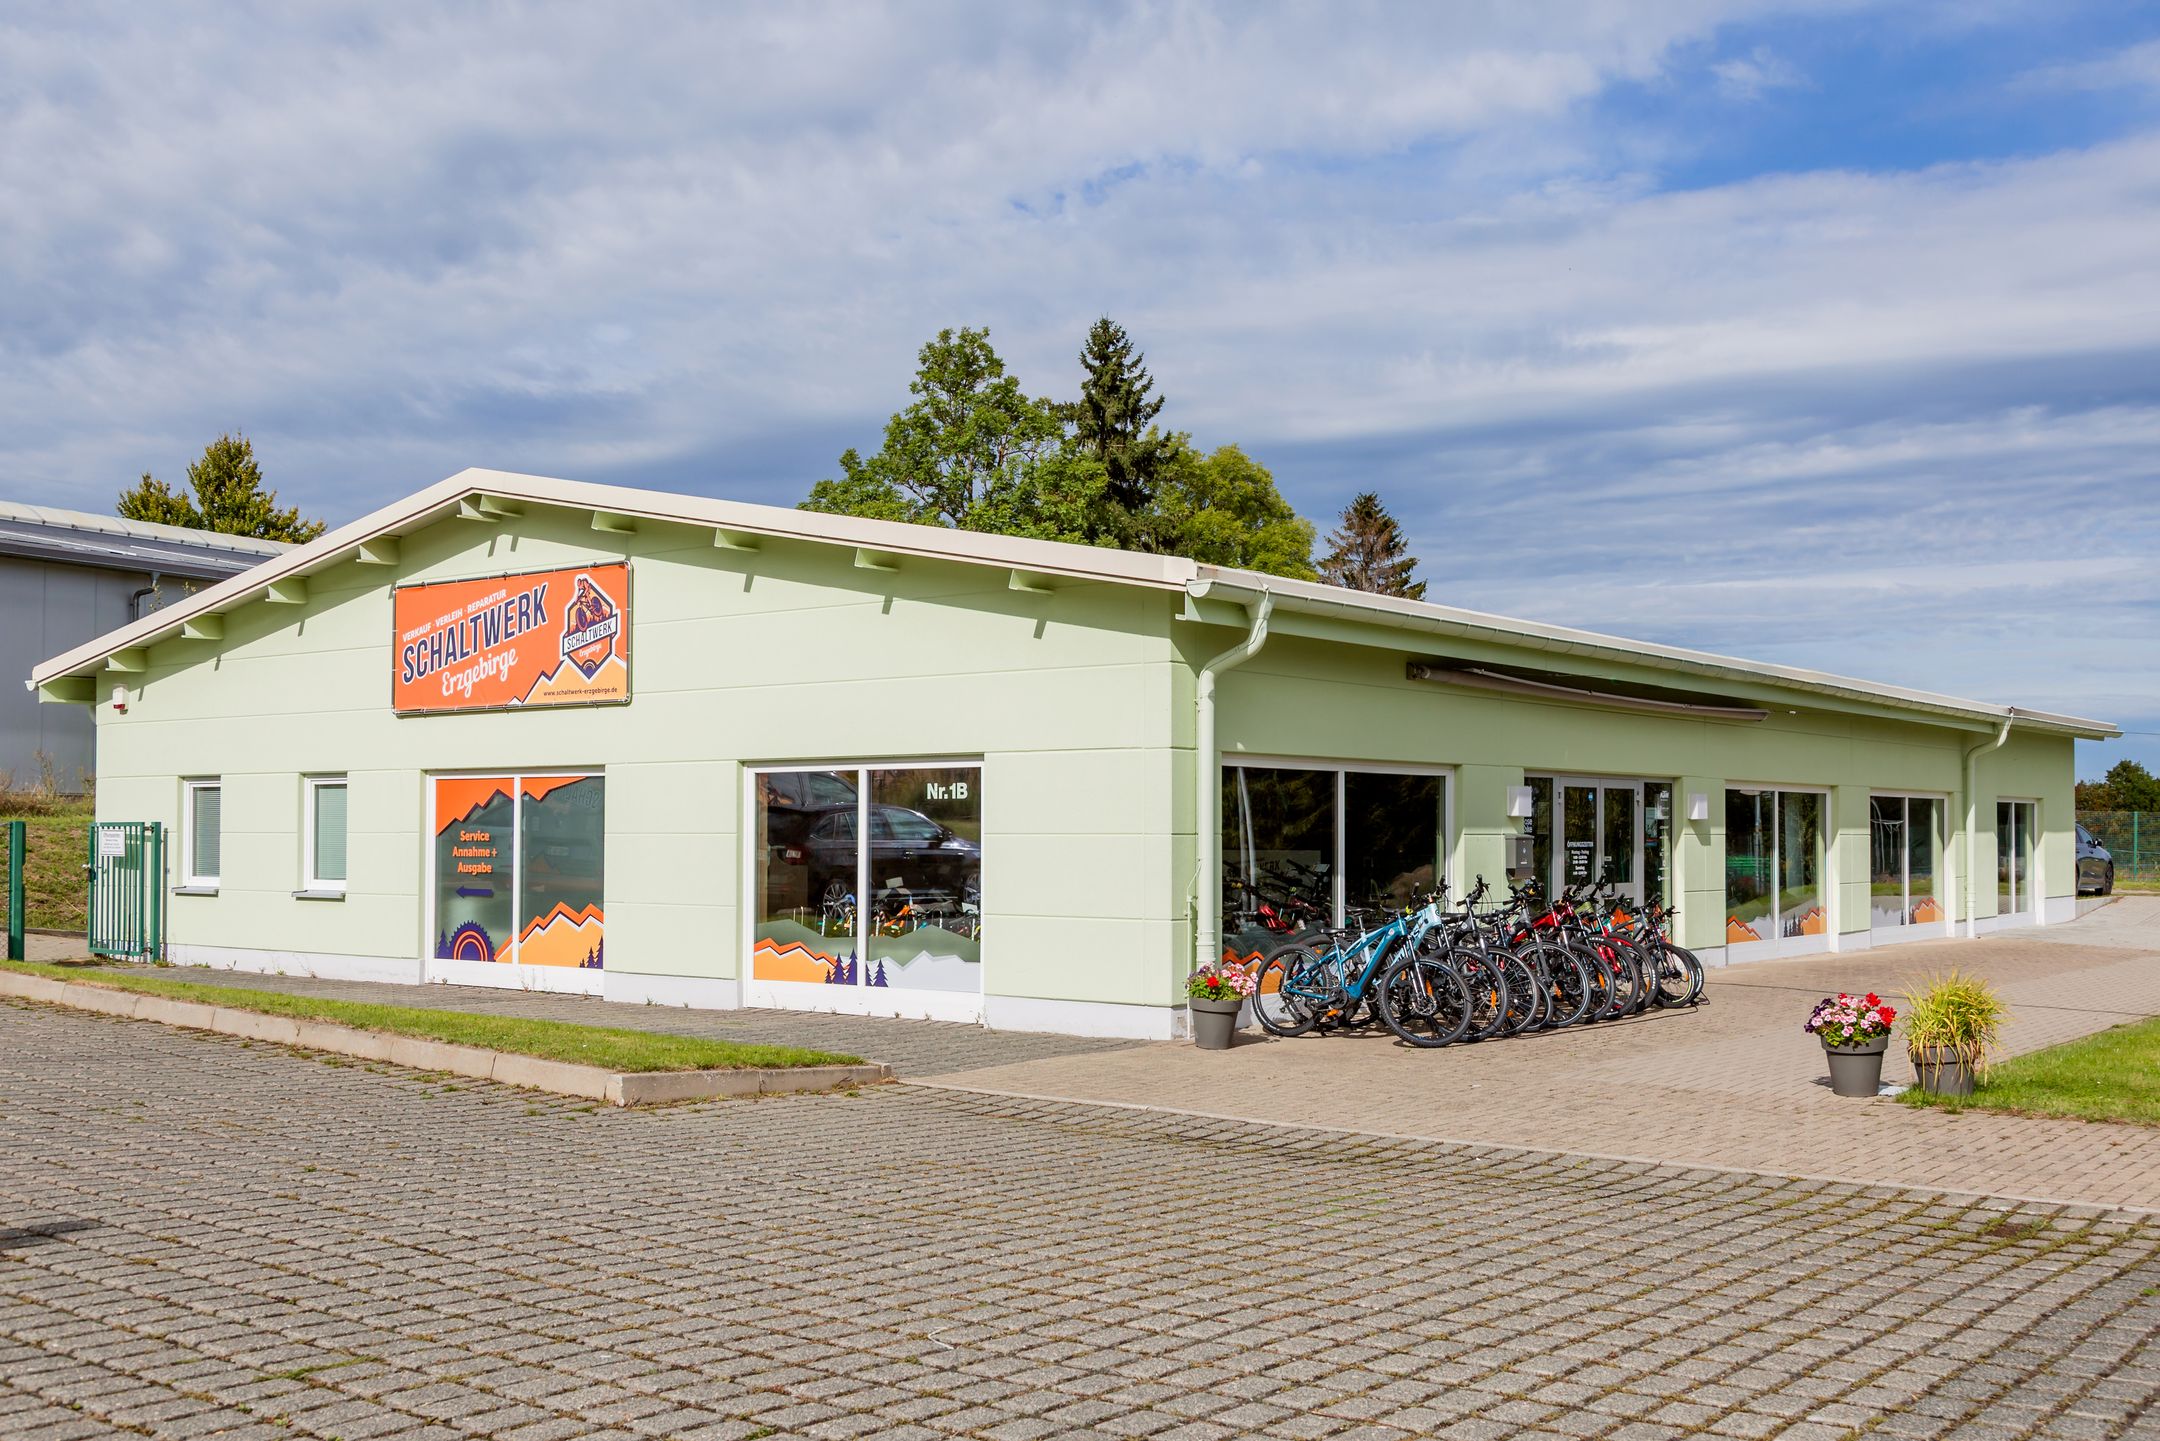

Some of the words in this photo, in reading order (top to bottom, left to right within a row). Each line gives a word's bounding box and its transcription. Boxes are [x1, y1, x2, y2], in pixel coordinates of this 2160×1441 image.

[402, 622, 431, 642] VERKAUF
[435, 608, 463, 627] VERLEIH
[467, 589, 507, 613] REPARATUR
[403, 583, 548, 684] SCHALTWERK
[567, 620, 613, 650] SCHALTWERK
[442, 648, 518, 698] Erzgebirge
[543, 687, 618, 696] www.schaltwerk-erzgebirge.de
[460, 830, 490, 841] Service
[452, 846, 490, 857] Annahme
[457, 862, 492, 875] Ausgabe
